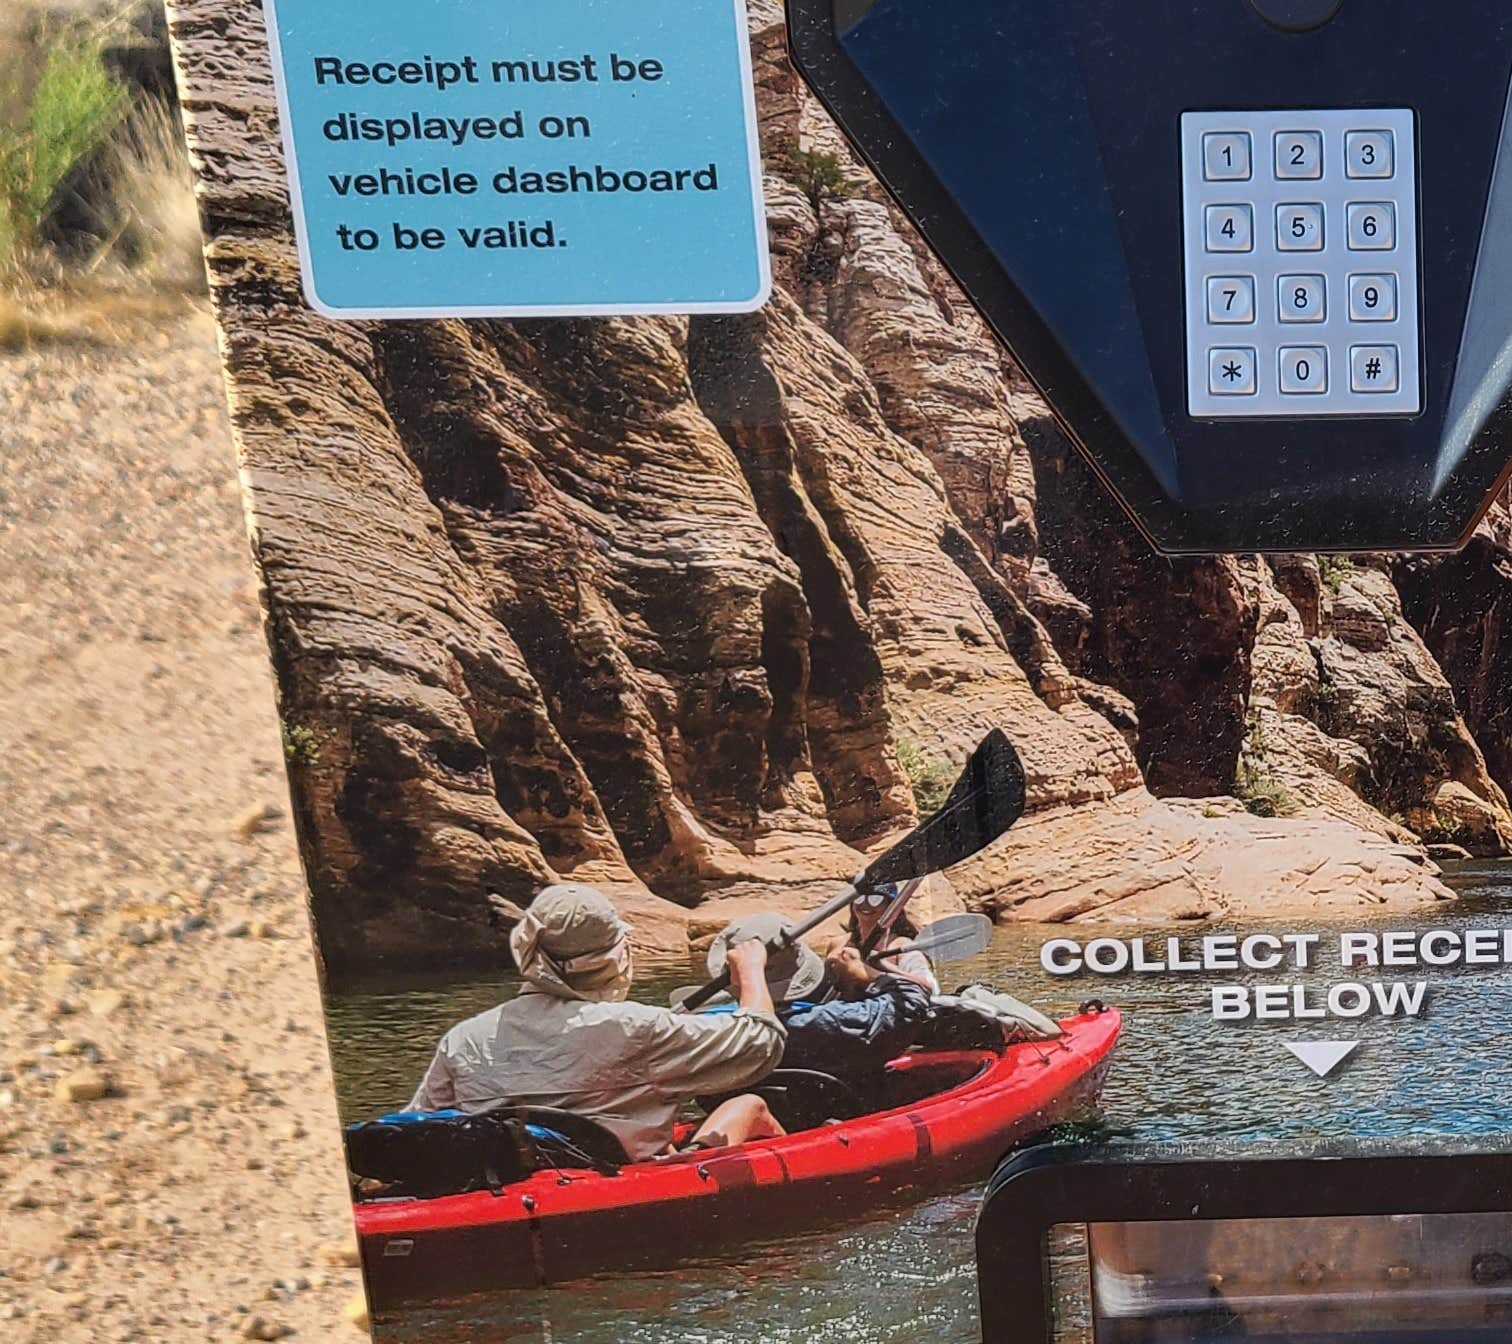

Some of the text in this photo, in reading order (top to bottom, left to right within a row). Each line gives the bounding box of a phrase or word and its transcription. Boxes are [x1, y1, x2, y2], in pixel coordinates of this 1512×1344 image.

[313, 53, 664, 90] Receipt must be
[322, 111, 590, 146] displayed on
[1221, 145, 1233, 167] 1
[1290, 144, 1305, 166] 2
[1361, 144, 1375, 165] 3
[328, 164, 718, 196] vehicle dashboard
[337, 220, 568, 252] to be valid.
[1220, 218, 1236, 239] 4
[1291, 217, 1306, 238] 5
[1362, 216, 1377, 237] 6
[1222, 290, 1237, 311] 7
[1294, 287, 1308, 309] 8
[1364, 287, 1379, 309] 9
[1296, 360, 1310, 381] 0
[1041, 934, 1319, 975] COLLECT
[1212, 981, 1426, 1020] BELOW
